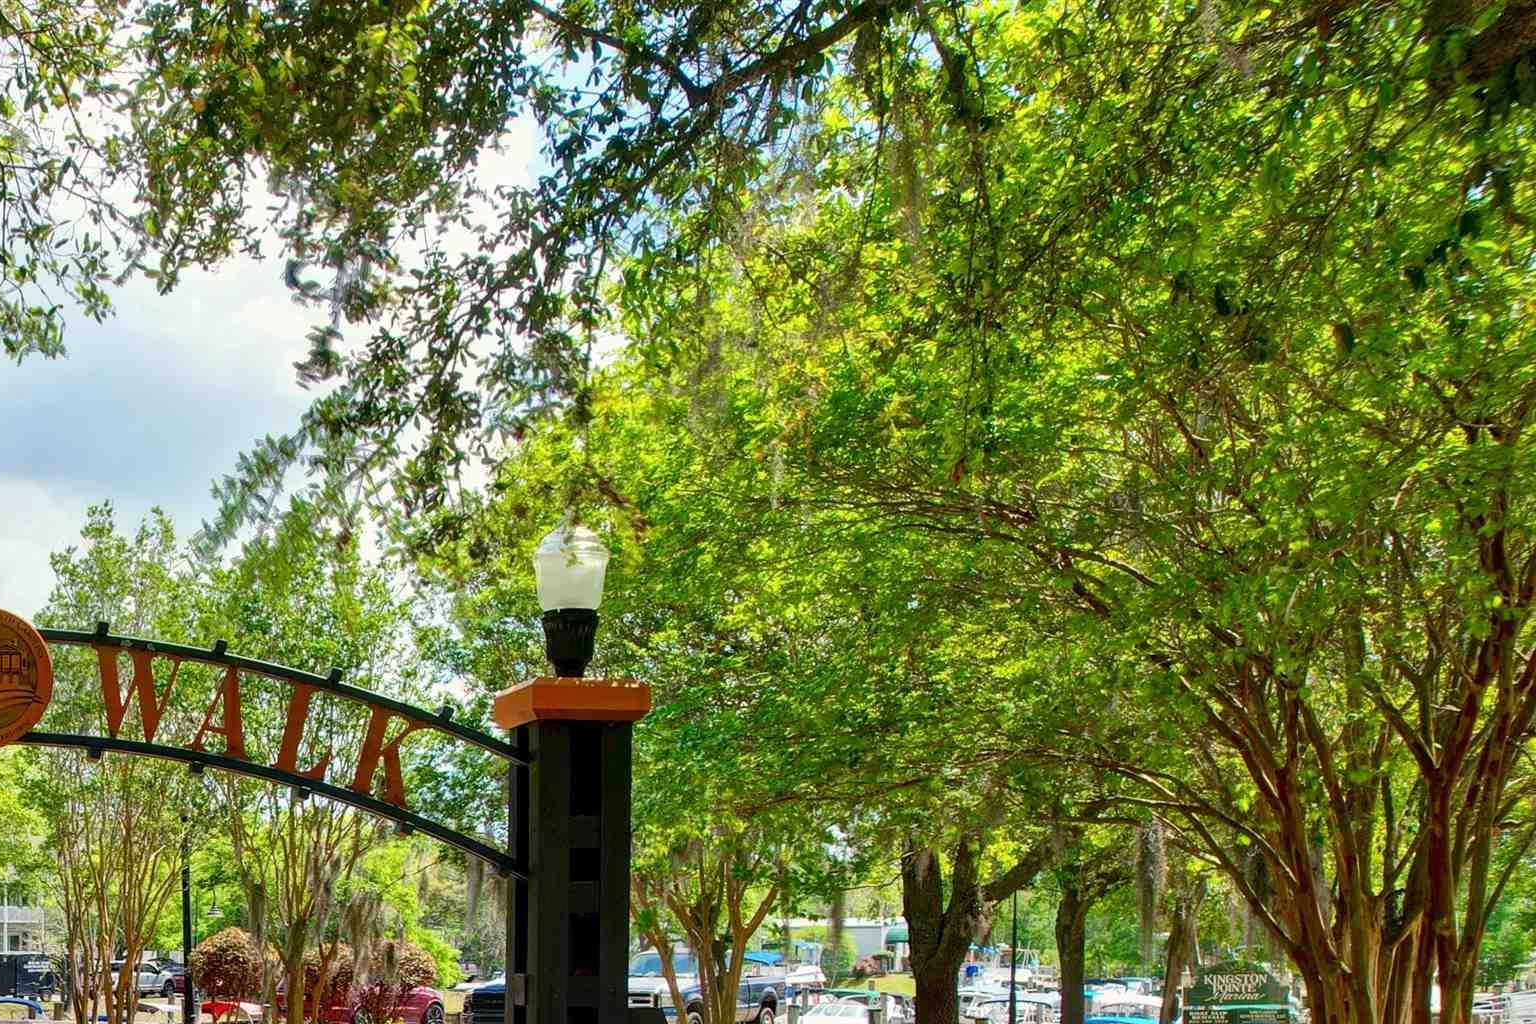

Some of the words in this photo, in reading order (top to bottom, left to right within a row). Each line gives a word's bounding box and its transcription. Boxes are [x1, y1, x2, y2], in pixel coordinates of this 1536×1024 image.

[92, 644, 434, 809] WALK
[1204, 974, 1267, 987] KINGSTON
[1212, 983, 1257, 994] POINTE
[1205, 991, 1266, 1003] Marina
